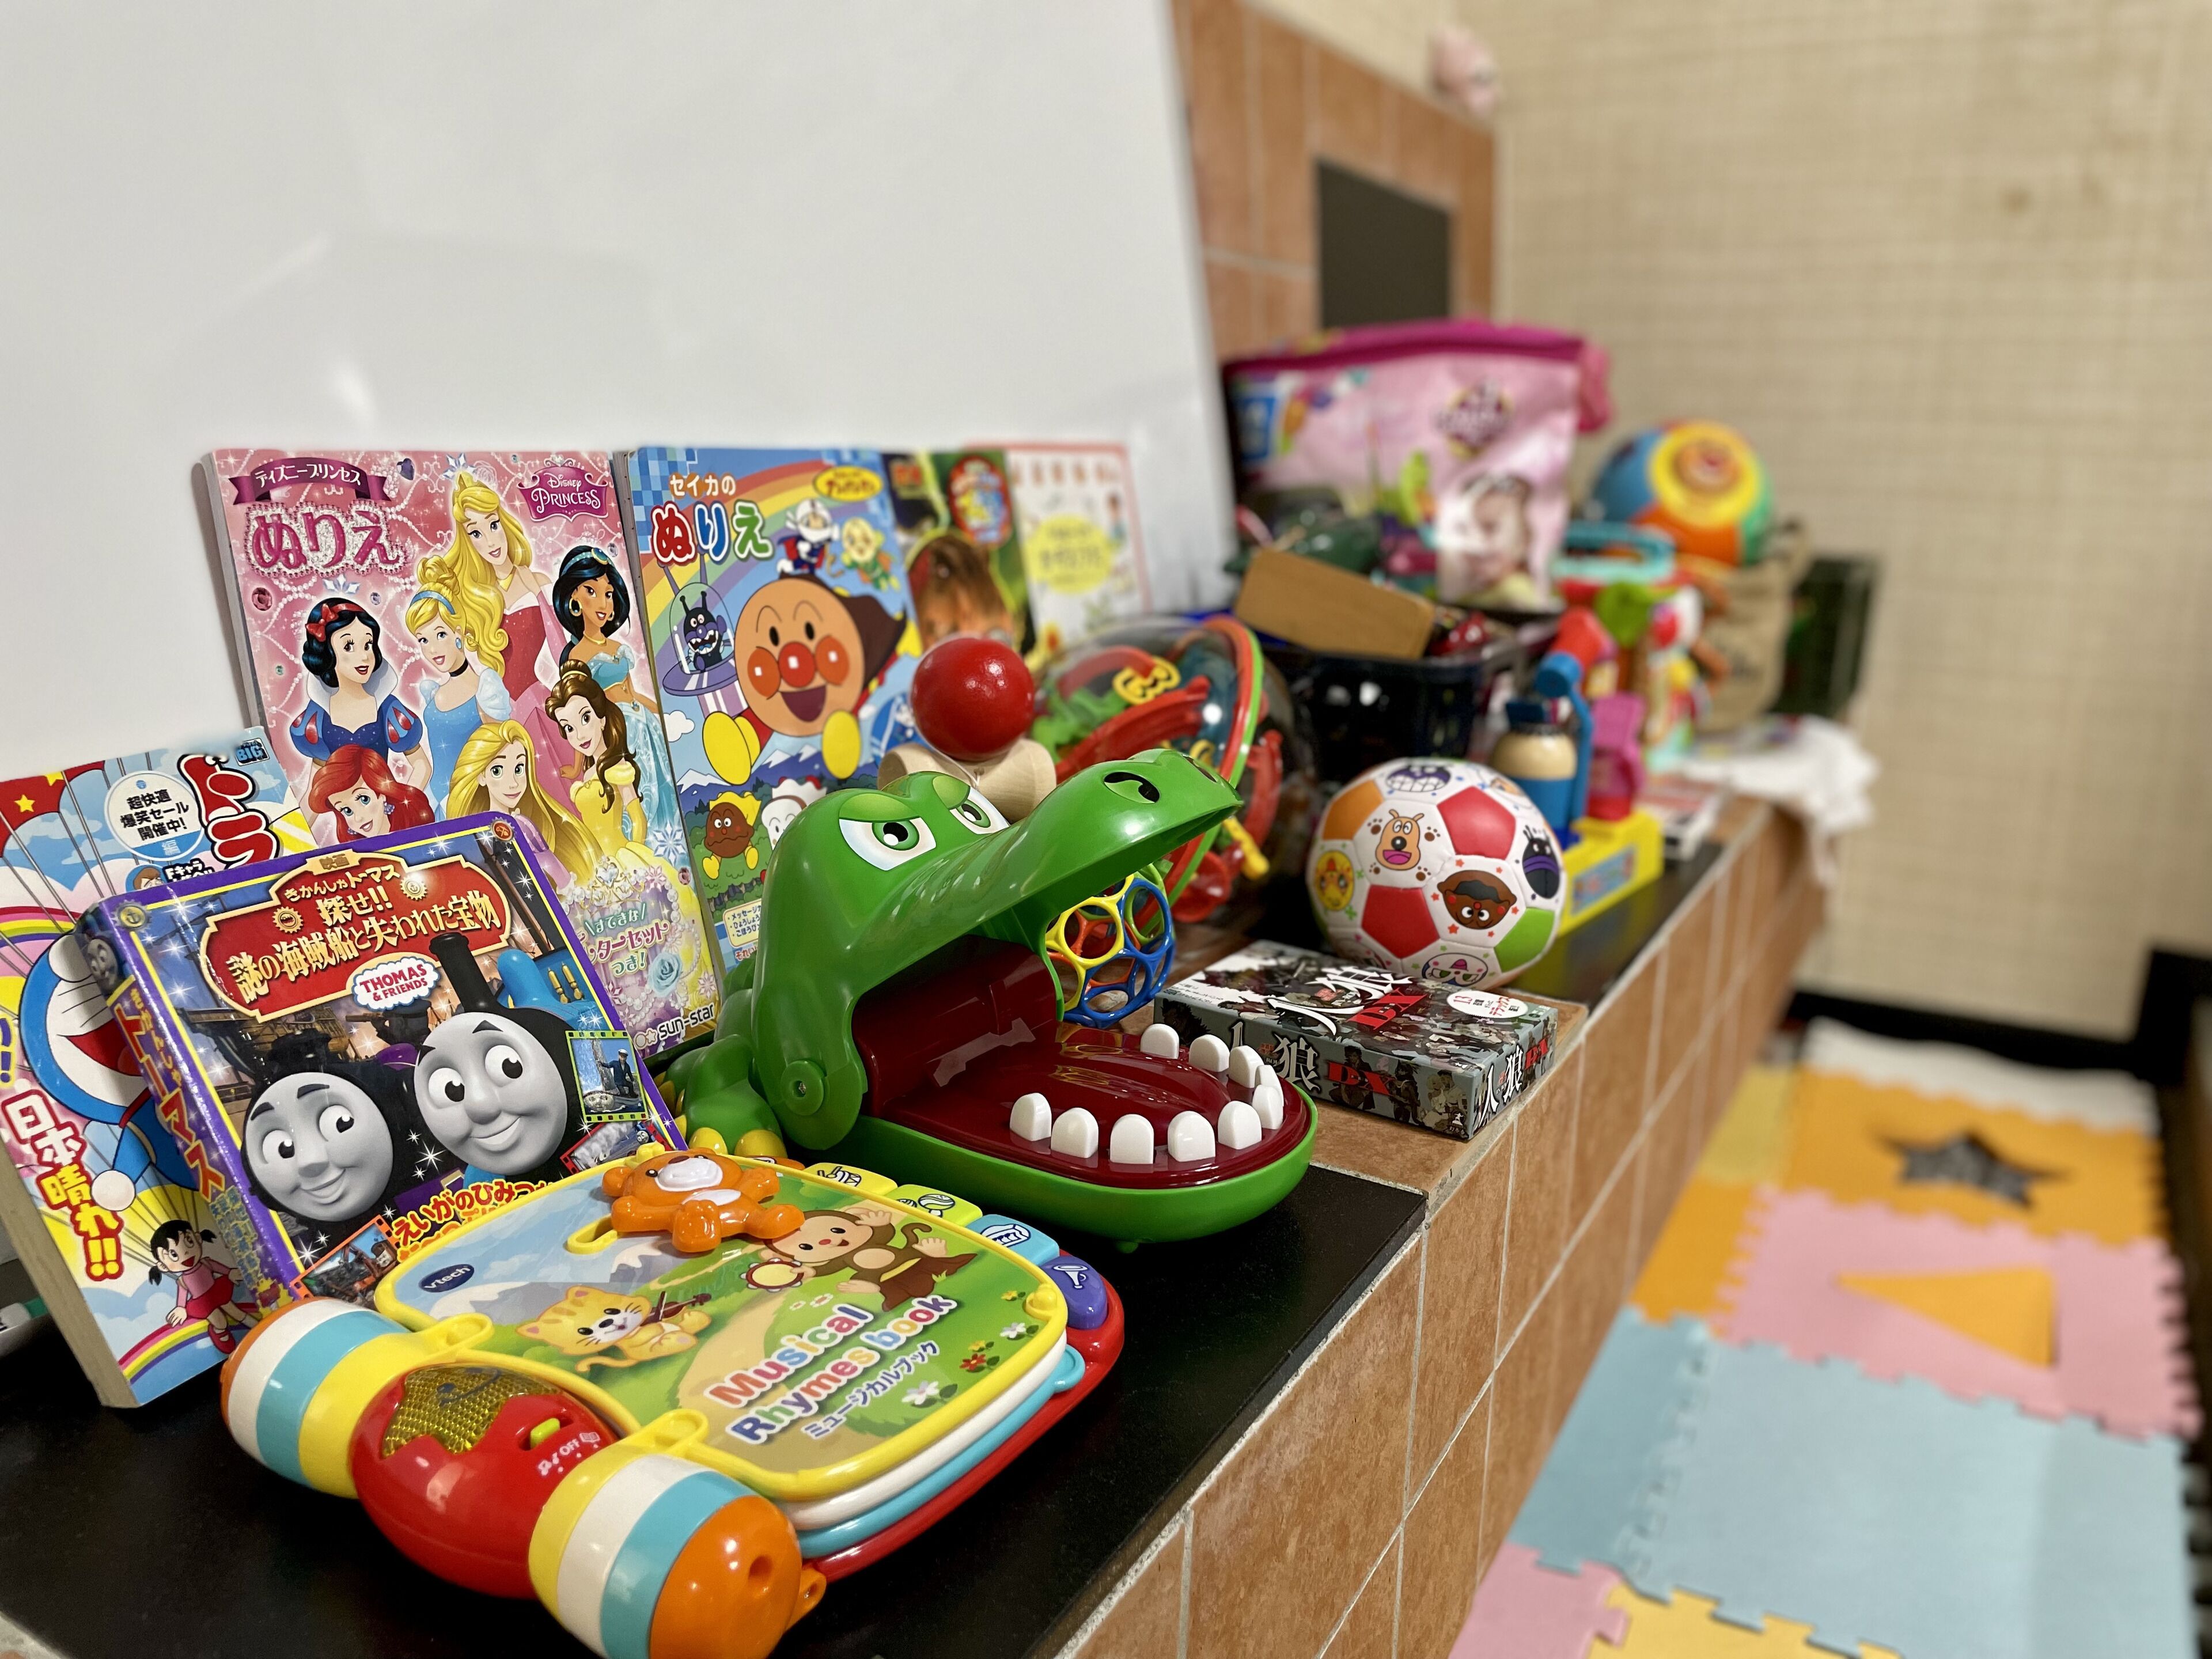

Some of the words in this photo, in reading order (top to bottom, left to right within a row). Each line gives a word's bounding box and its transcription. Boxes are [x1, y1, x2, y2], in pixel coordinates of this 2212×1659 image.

[255, 464, 361, 488] ディズニープリンセス
[669, 475, 736, 498] セイカの
[252, 510, 400, 570] ぬりえ
[652, 501, 774, 563] ぬりえ
[236, 745, 264, 761] BIG
[120, 801, 189, 828] 爆笑セール
[127, 789, 172, 810] 超快適
[137, 817, 187, 840] 開催中!
[285, 864, 400, 902] きかんしゃトーマス
[316, 885, 393, 926] 探せ!!
[225, 890, 502, 1004] 謎の海賊船と失われた宝物
[359, 963, 427, 994] THOMAS
[373, 991, 382, 1002] &
[382, 978, 428, 998] FRIENDS
[115, 1003, 225, 1203] トーマス
[4, 1092, 122, 1279] 日本晴れ!!
[395, 1181, 548, 1246] えいがのひみつ
[707, 1305, 871, 1407] Musical
[729, 1348, 877, 1442] Rhymes
[863, 1297, 954, 1348] book
[804, 1340, 939, 1438] ミュージカルブック
